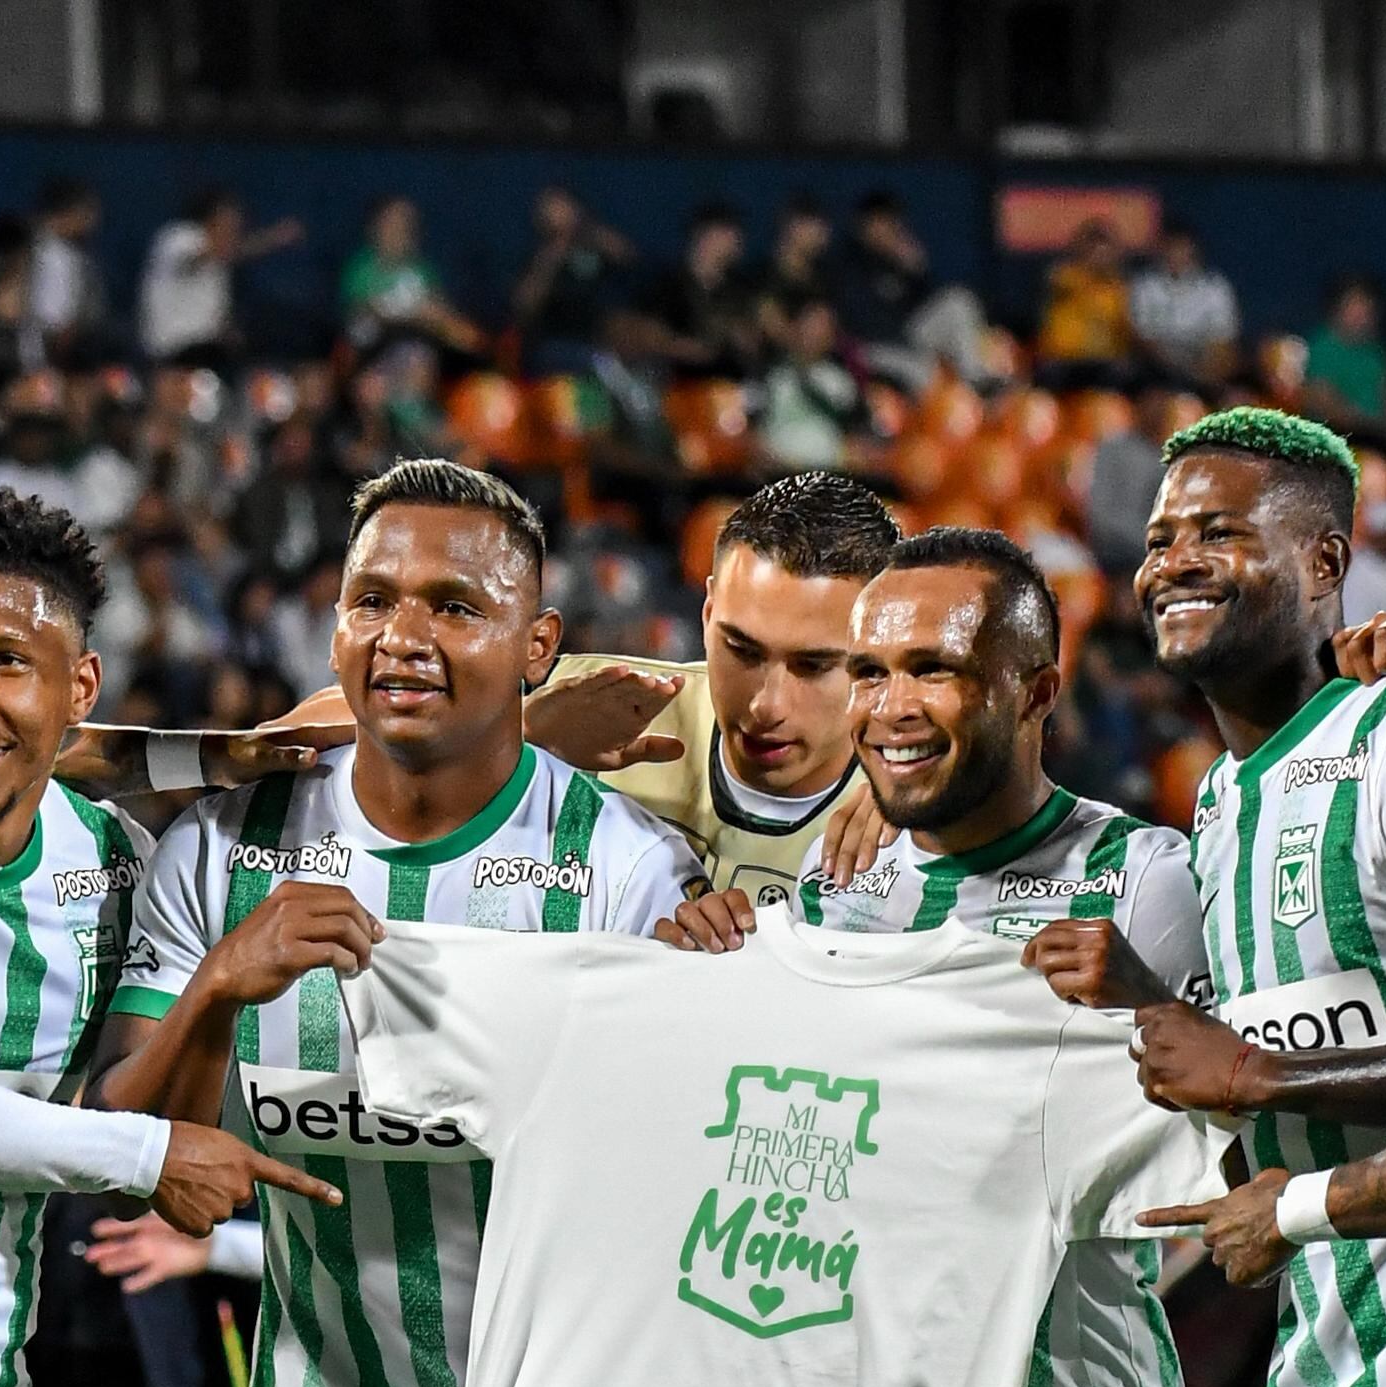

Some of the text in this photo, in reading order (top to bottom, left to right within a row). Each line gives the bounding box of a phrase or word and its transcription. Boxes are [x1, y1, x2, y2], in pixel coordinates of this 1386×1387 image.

[785, 1103, 818, 1131] MI
[733, 1125, 853, 1169] PRIMERA
[727, 1152, 849, 1202] HINCHA
[764, 1192, 807, 1228] es
[679, 1187, 859, 1291] Mamá
